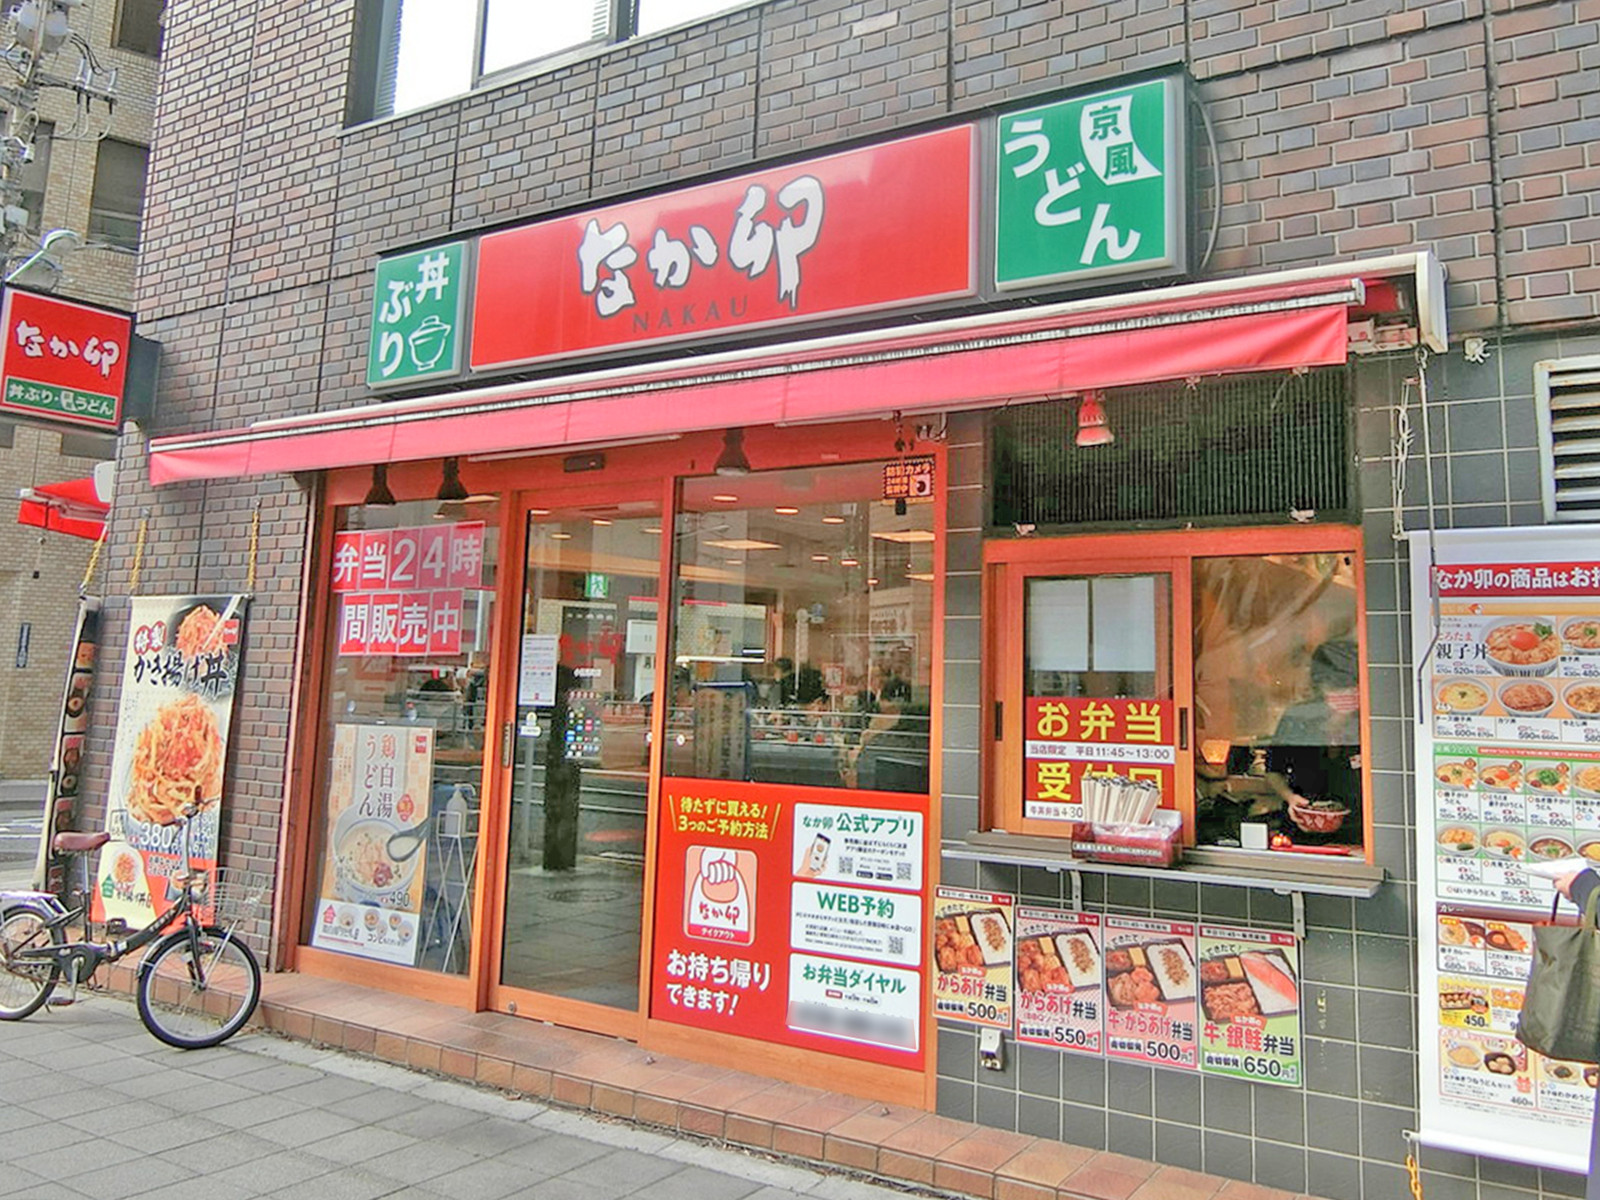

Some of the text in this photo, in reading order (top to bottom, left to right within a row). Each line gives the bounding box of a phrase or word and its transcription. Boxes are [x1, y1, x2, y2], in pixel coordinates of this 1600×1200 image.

[1089, 105, 1138, 181] 京風
[1003, 118, 1142, 265] うどん
[578, 173, 825, 317] なか卯
[377, 251, 451, 378] 丼ぶり
[631, 295, 749, 334] NAKAU
[15, 319, 121, 380] なか卯
[333, 533, 481, 583] 弁当24時
[341, 601, 459, 645] 間販売中
[1435, 643, 1489, 660] 親子丼
[133, 650, 229, 696] かき揚げ丼
[1036, 701, 1162, 743] お弁当
[1029, 744, 1067, 756] 当店限定
[358, 734, 379, 818] うどん
[680, 796, 769, 819] 待たずに買える!
[678, 815, 769, 840] 3つのご予約方法
[698, 901, 740, 926] なか卯
[816, 890, 896, 920] WEB予約
[666, 949, 771, 992] お持ち帰り
[802, 963, 907, 994] お弁当ダイヤル
[936, 973, 1007, 1003] からあげ弁当
[666, 982, 740, 1016] できます!
[1019, 990, 1097, 1020] からあげ弁当
[1107, 1008, 1193, 1042] 牛・からあげ弁当
[1203, 1021, 1295, 1057] 牛・銀鮭弁当
